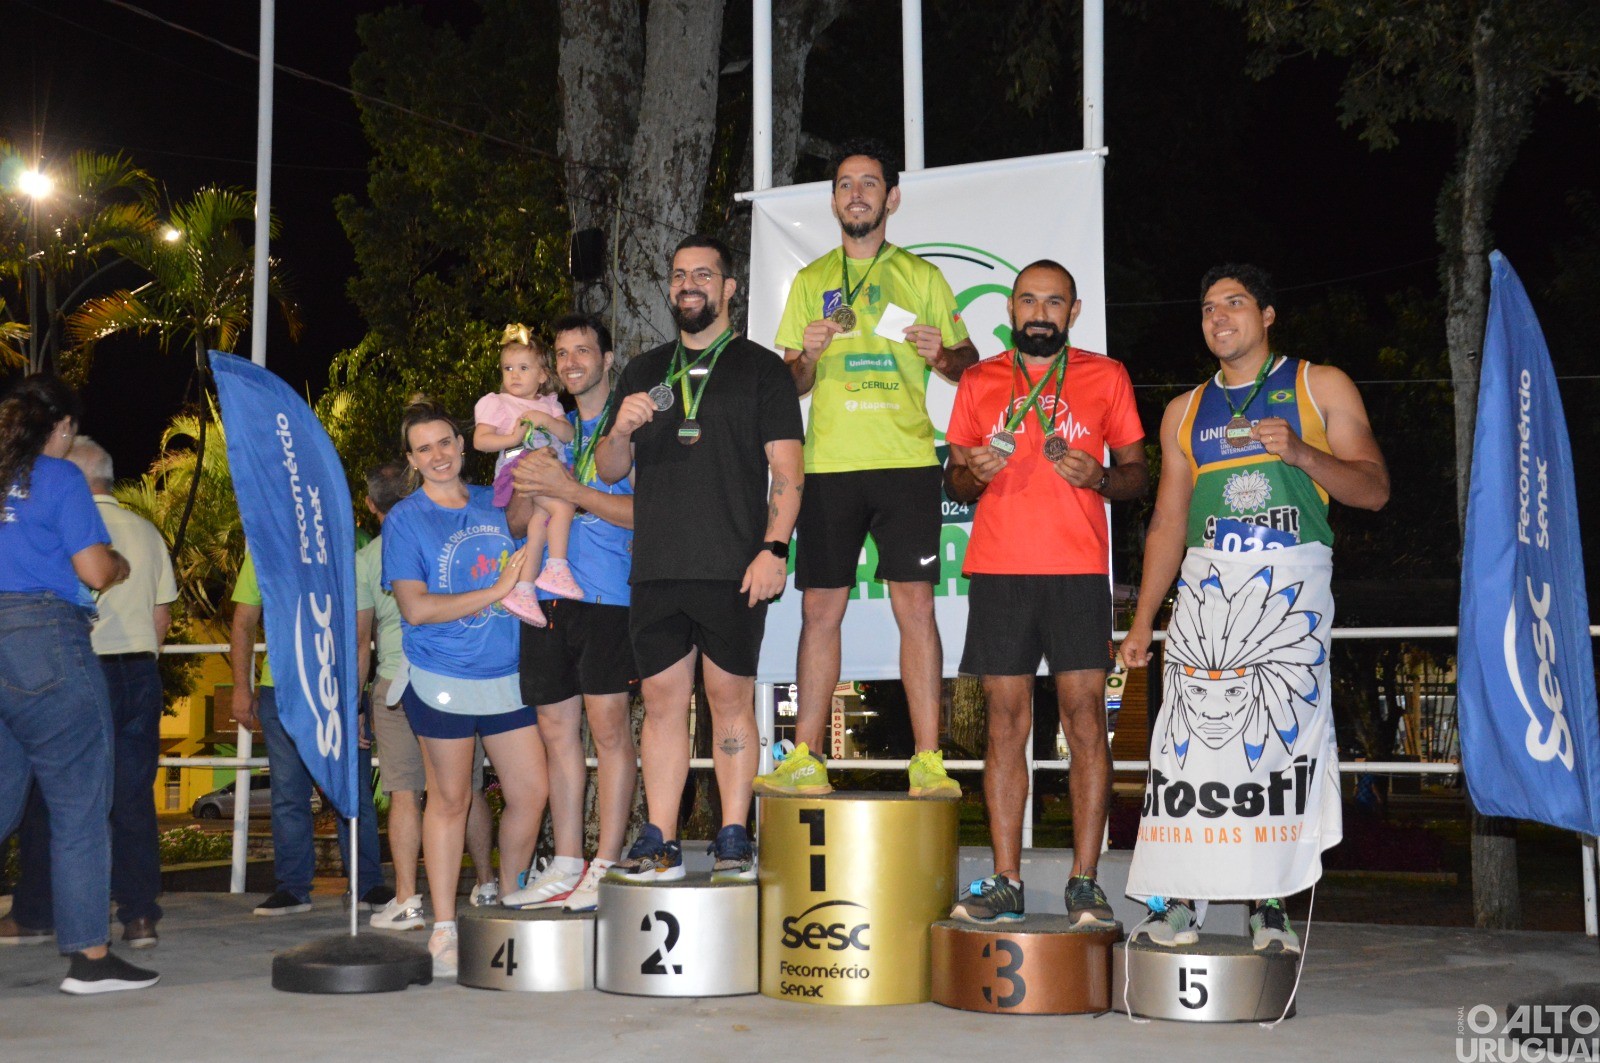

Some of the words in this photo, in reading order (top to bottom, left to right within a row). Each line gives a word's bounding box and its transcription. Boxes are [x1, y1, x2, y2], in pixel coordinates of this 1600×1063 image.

[849, 359, 881, 367] Unimed
[861, 381, 900, 391] CERILUZ
[1221, 443, 1263, 456] INTERNACIONAL
[1518, 369, 1531, 545] Fecomércio
[276, 412, 313, 565] Fecomércio
[941, 501, 969, 516] 024
[1536, 456, 1549, 551] Senac
[307, 484, 329, 566] Senac
[437, 542, 454, 588] FAMÍLIA
[449, 528, 468, 543] QUE
[466, 525, 501, 536] CORRE
[798, 808, 826, 892] 1
[1204, 827, 1242, 844] DAS
[640, 910, 683, 975] 2
[781, 908, 871, 951] Sesc
[490, 938, 518, 977] 4
[780, 960, 870, 979] Fecomércio
[981, 939, 1027, 1008] 3
[780, 981, 824, 998] Senac
[1178, 967, 1208, 1010] 5
